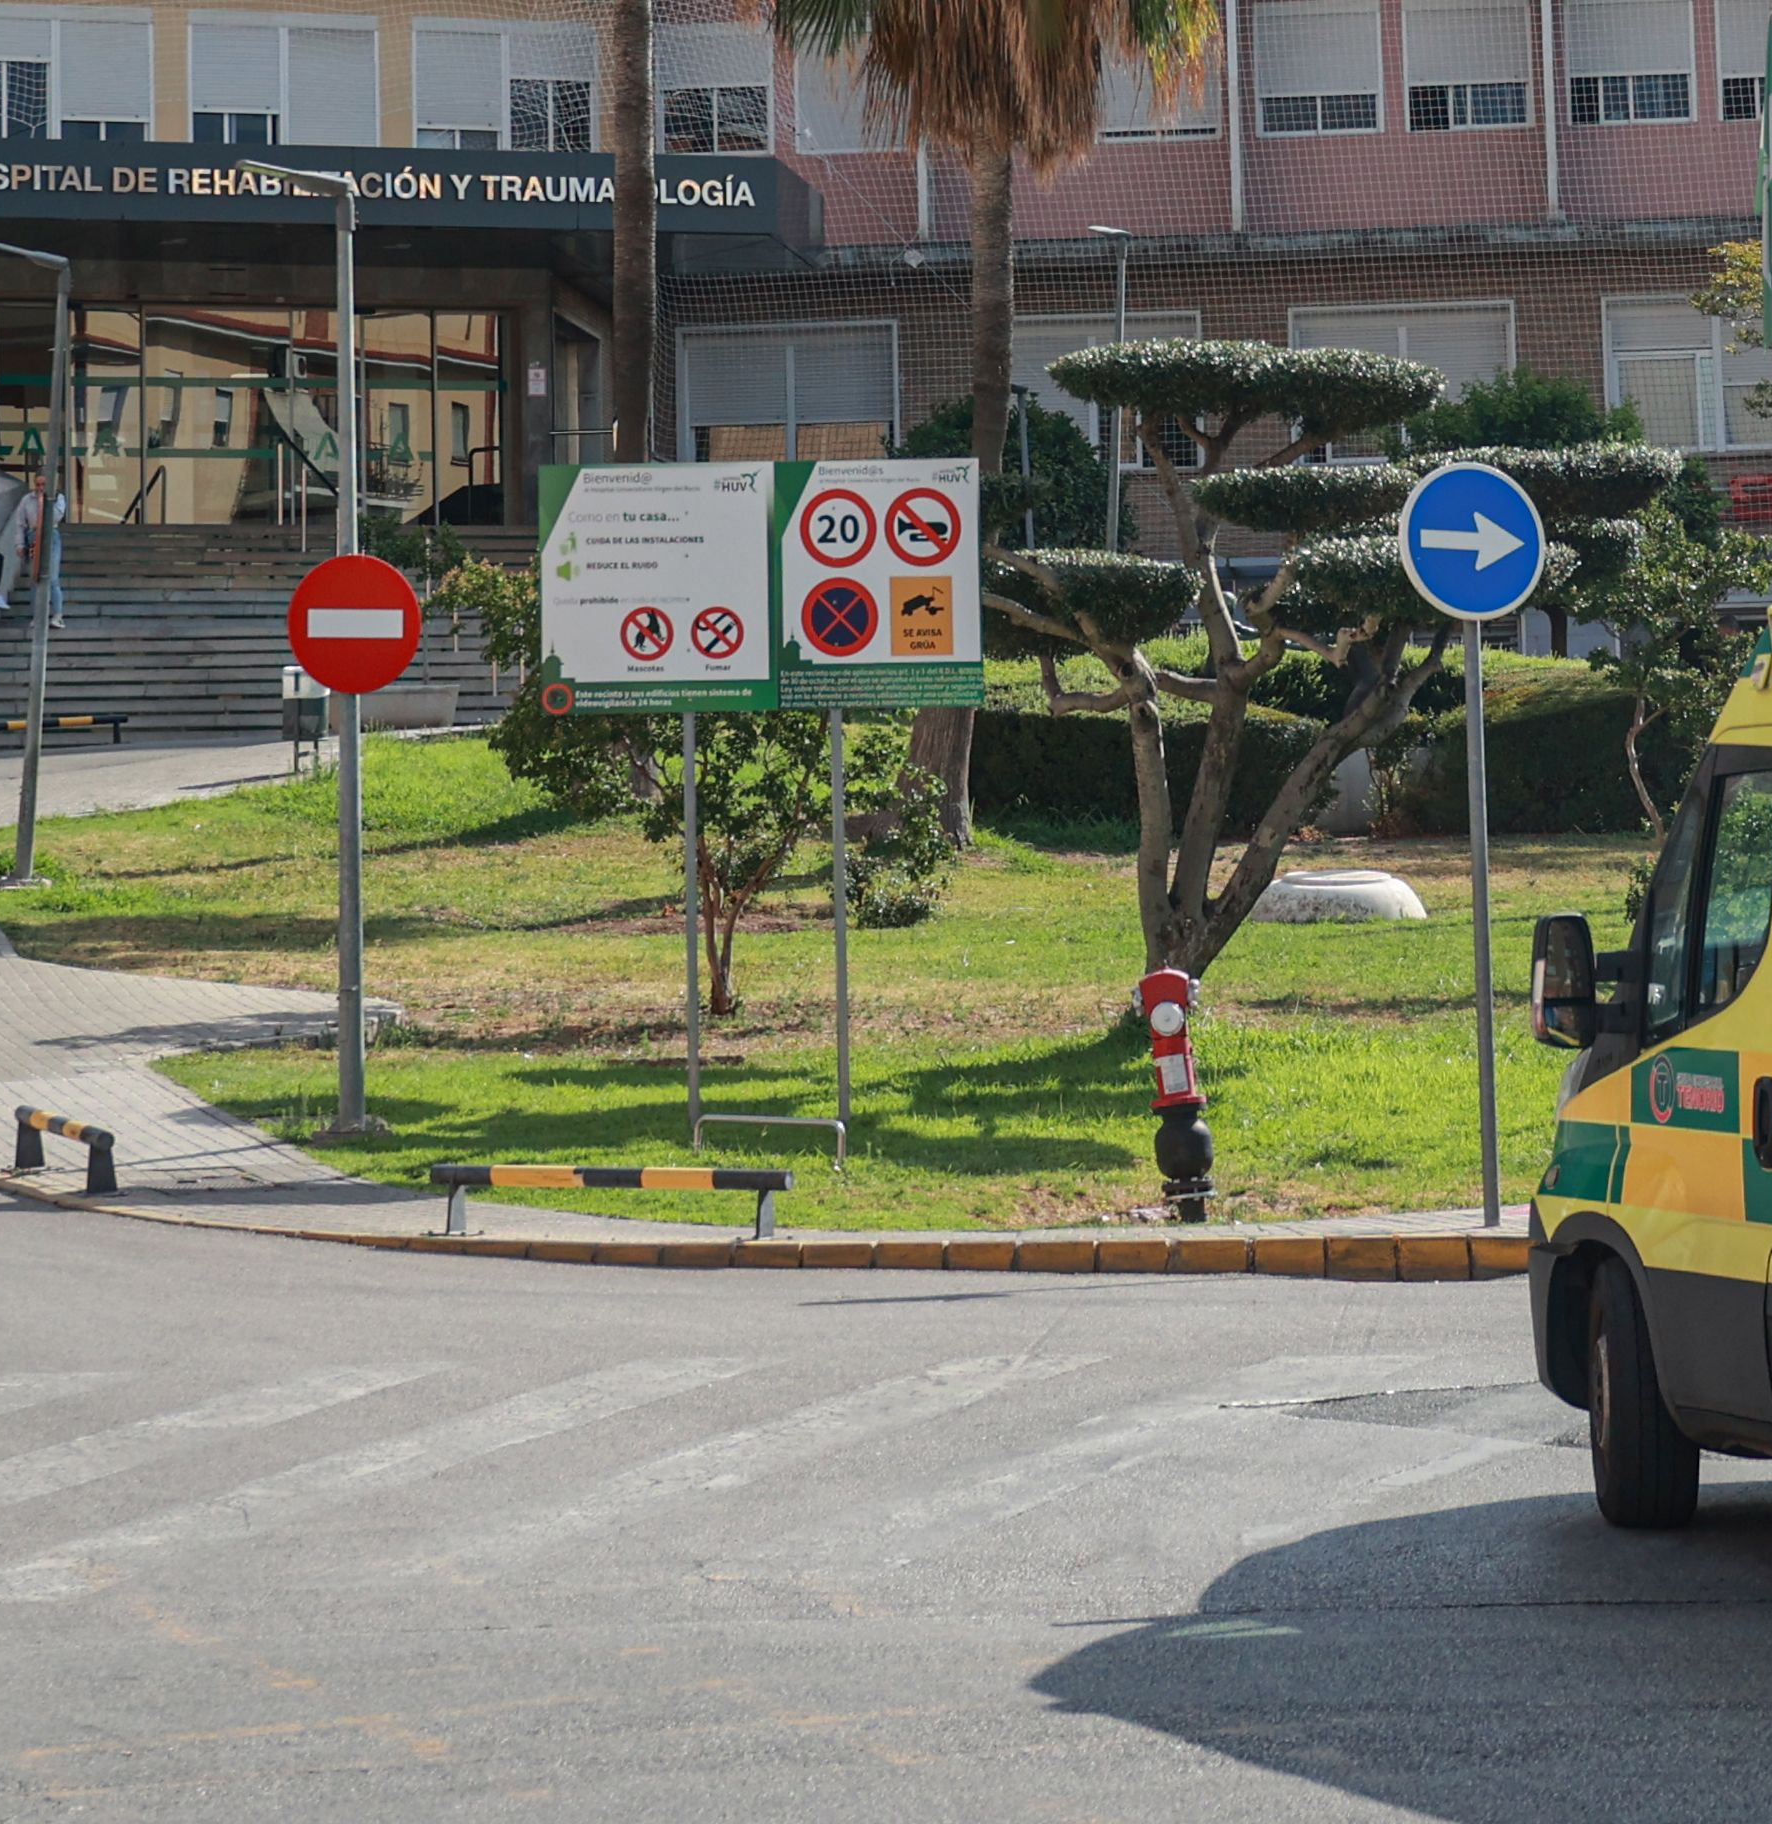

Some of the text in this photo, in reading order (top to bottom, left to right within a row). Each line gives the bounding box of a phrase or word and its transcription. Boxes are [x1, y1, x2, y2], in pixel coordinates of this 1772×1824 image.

[113, 167, 158, 193] DE
[168, 166, 441, 200] REHABIACIÓN
[450, 174, 472, 200] Y
[480, 174, 756, 207] TRAUMALOGÍA
[583, 471, 653, 486] Bienvenid@
[568, 511, 603, 523] Como
[606, 513, 621, 523] en
[623, 512, 637, 522] tu
[817, 514, 860, 544] 20
[586, 535, 705, 545] CUIDA DE LAS INSTALACIONES
[586, 561, 658, 570] REDUCE EL RUIDO
[580, 595, 619, 606] prohibido
[903, 628, 943, 638] SE AVISA
[909, 639, 936, 651] GRÚA
[627, 664, 664, 673] Mascotas
[705, 663, 731, 671] Fumar
[1676, 1084, 1725, 1114] TENORIO
